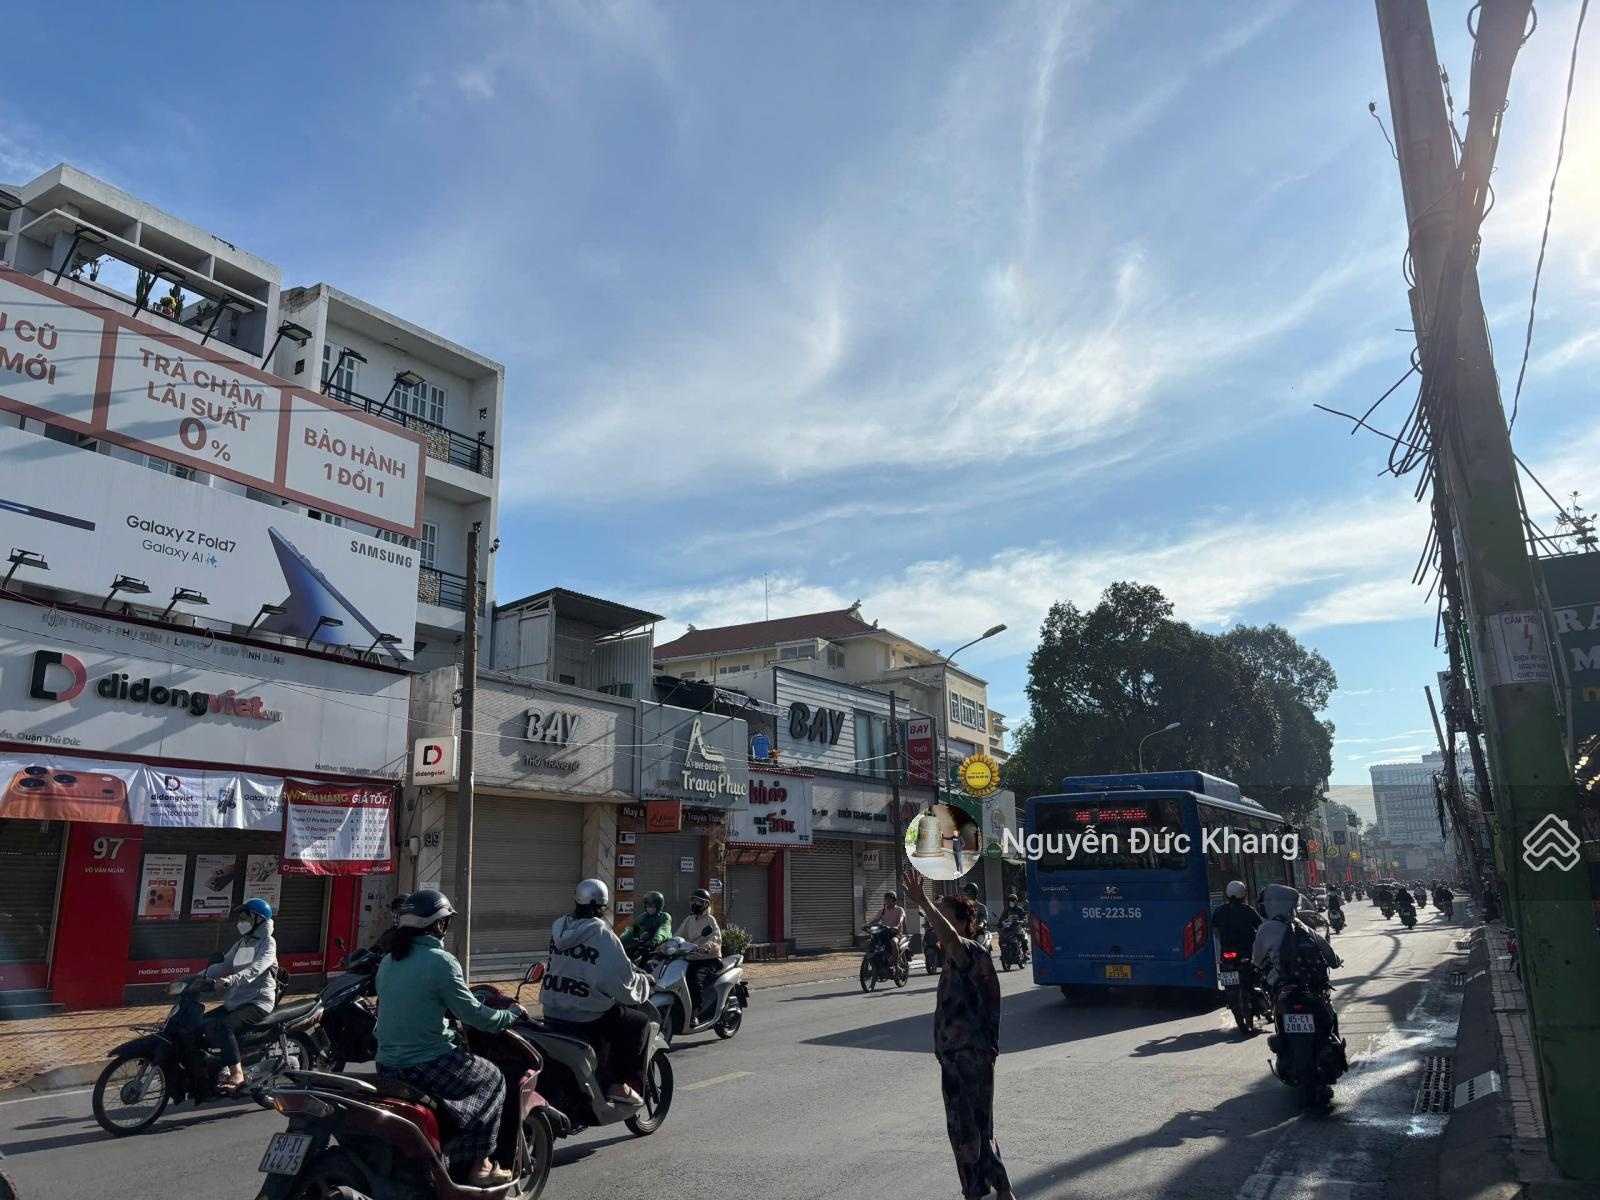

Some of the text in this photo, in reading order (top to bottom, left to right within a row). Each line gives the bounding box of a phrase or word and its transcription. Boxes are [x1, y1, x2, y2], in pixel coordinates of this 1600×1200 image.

[15, 319, 58, 350] CŨ
[139, 347, 262, 410] TRẢ CHẬM
[147, 381, 251, 432] LÃI SUẤT
[304, 427, 406, 480] BẢO HÀNH
[324, 462, 384, 498] 1 ĐỔI 1
[126, 514, 237, 553] Galaxy Z Fold7
[142, 539, 204, 563] Galaxy AI
[350, 540, 413, 568] SAMSUNG
[527, 707, 580, 745] BAY
[788, 702, 845, 745] BAY
[909, 723, 929, 735] BAY
[352, 791, 368, 804] GIÁ
[369, 791, 388, 805] TỐT.
[681, 769, 748, 801] Trang Phục
[622, 806, 638, 818] May
[93, 836, 125, 861] 97
[1082, 907, 1142, 919] 50E-223.56
